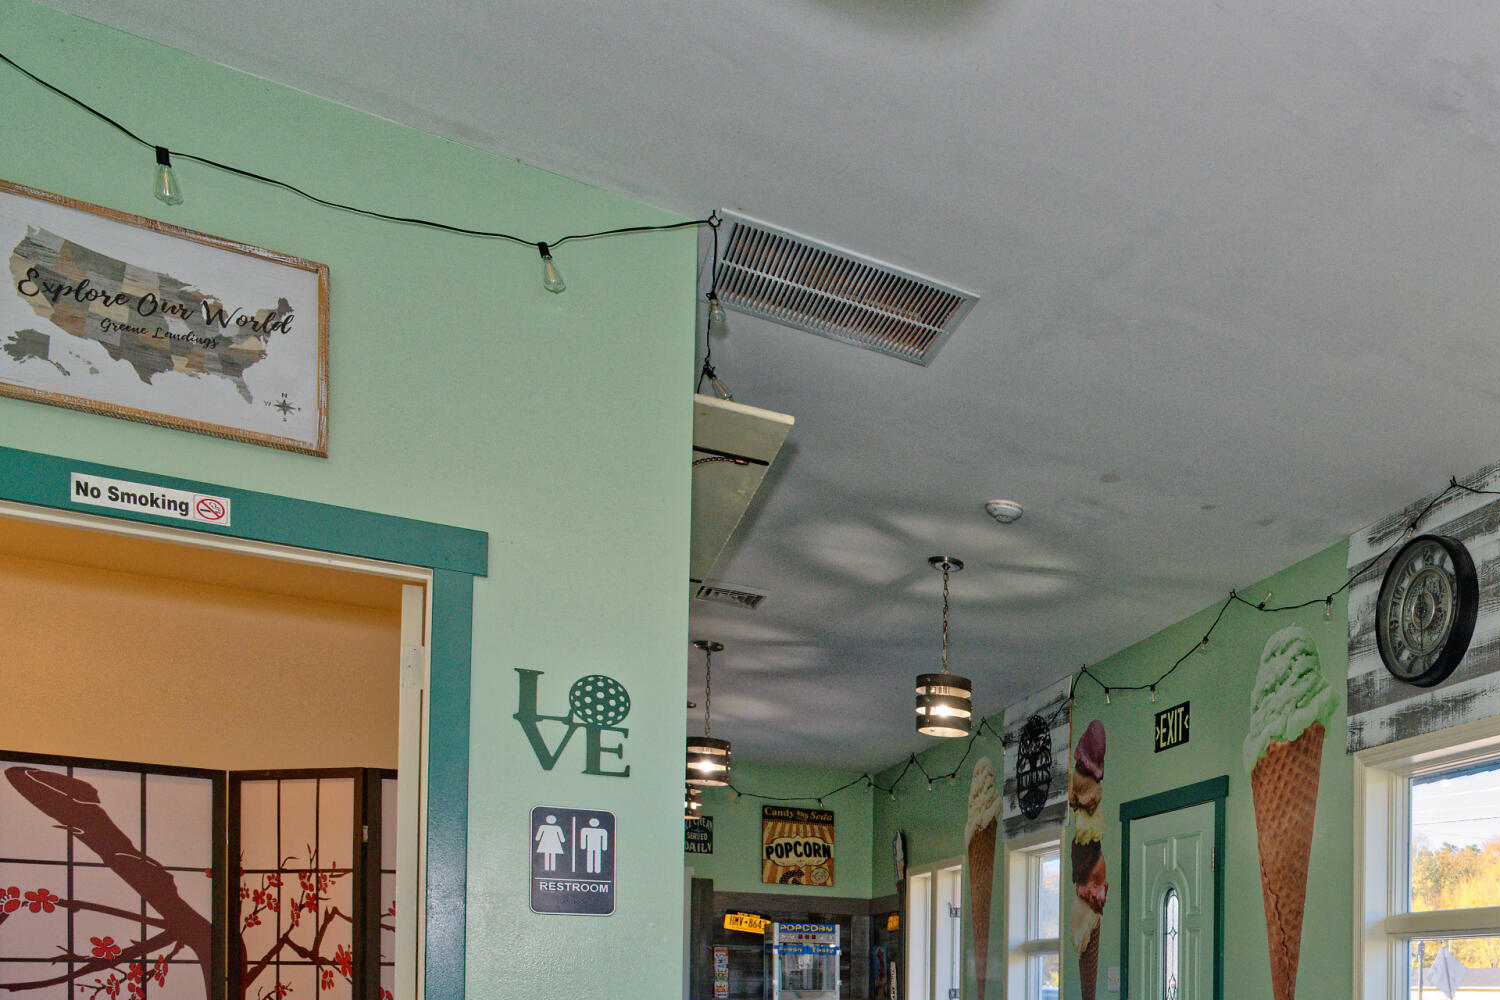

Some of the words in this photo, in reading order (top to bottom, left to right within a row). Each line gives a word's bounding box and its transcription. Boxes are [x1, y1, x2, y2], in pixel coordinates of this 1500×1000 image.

[17, 267, 130, 307] Explore
[136, 292, 194, 320] Our
[200, 299, 295, 335] World
[100, 317, 148, 335] Greene
[152, 326, 219, 349] Landings
[75, 480, 101, 499] No
[107, 485, 189, 517] Smoking
[1160, 706, 1185, 748] EXIT
[764, 806, 795, 818] Candy
[810, 811, 833, 821] Soda
[765, 841, 831, 860] POPCORN
[539, 881, 609, 893] RESTROOM
[780, 924, 833, 932] POPCORN
